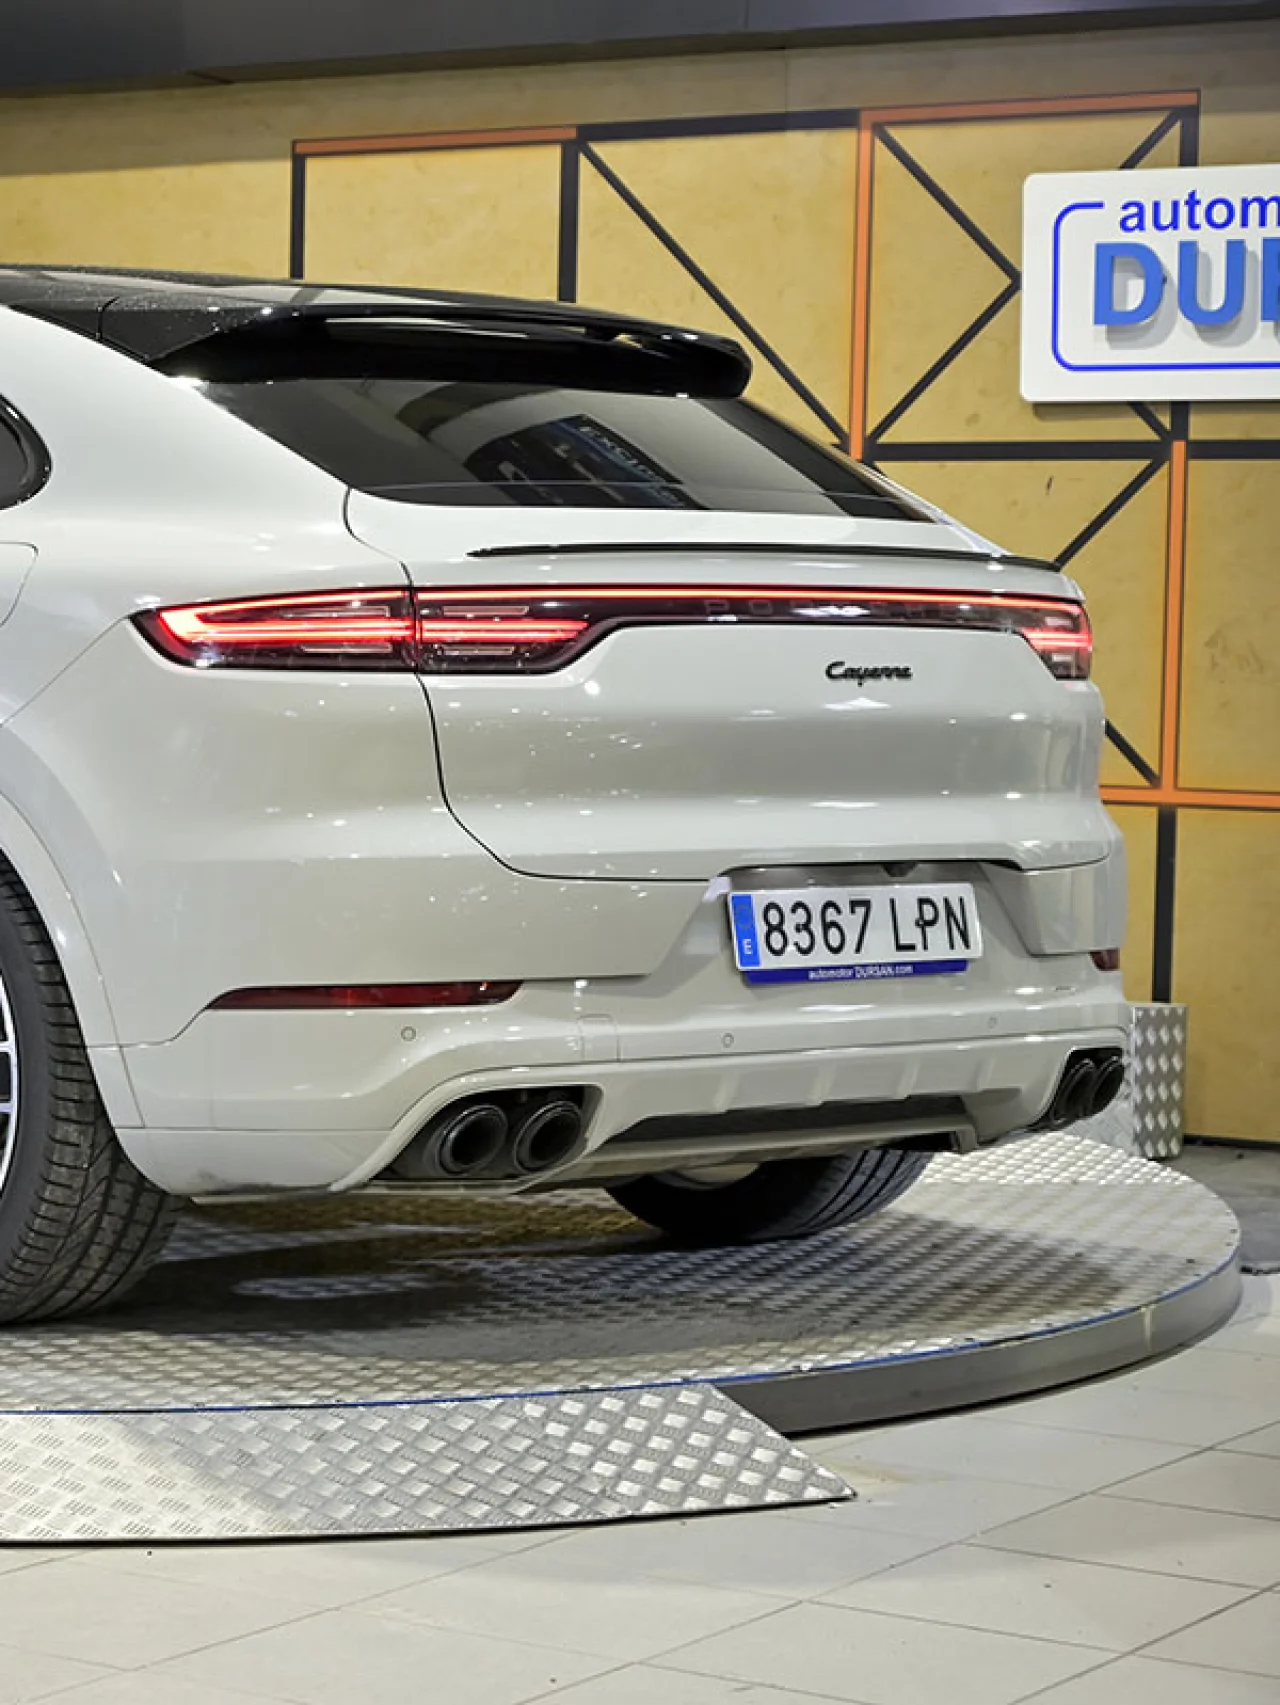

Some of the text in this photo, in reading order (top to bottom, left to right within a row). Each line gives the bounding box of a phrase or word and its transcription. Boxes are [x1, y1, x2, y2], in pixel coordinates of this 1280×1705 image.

[825, 661, 912, 687] Cayenne
[742, 896, 971, 956] E 8367 LPN
